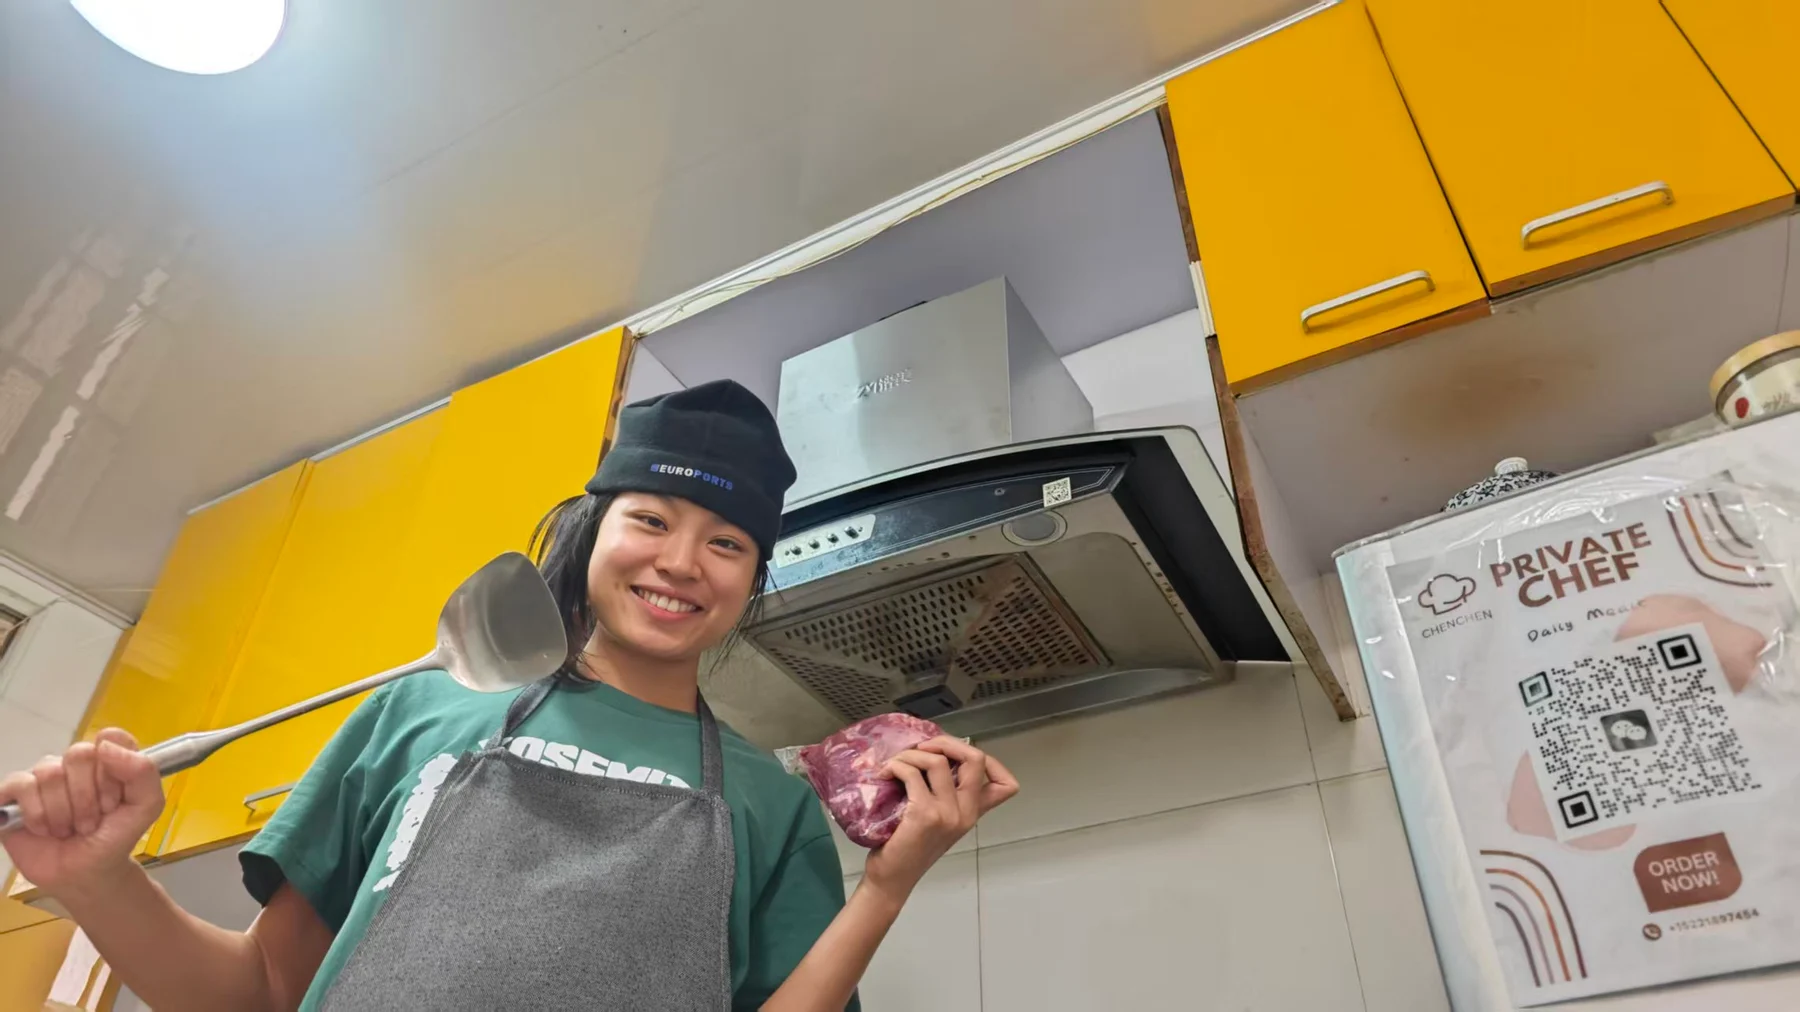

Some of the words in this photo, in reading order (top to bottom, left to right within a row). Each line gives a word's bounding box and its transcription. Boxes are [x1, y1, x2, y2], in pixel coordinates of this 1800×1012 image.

[659, 464, 734, 491] EUROPORTS
[1489, 522, 1652, 588] PRIVATE
[1518, 552, 1640, 608] CHEF
[1421, 609, 1493, 639] CHENCHEN
[1527, 620, 1574, 642] Daily
[1648, 851, 1720, 877] ORDER
[1661, 870, 1721, 894] NOW!
